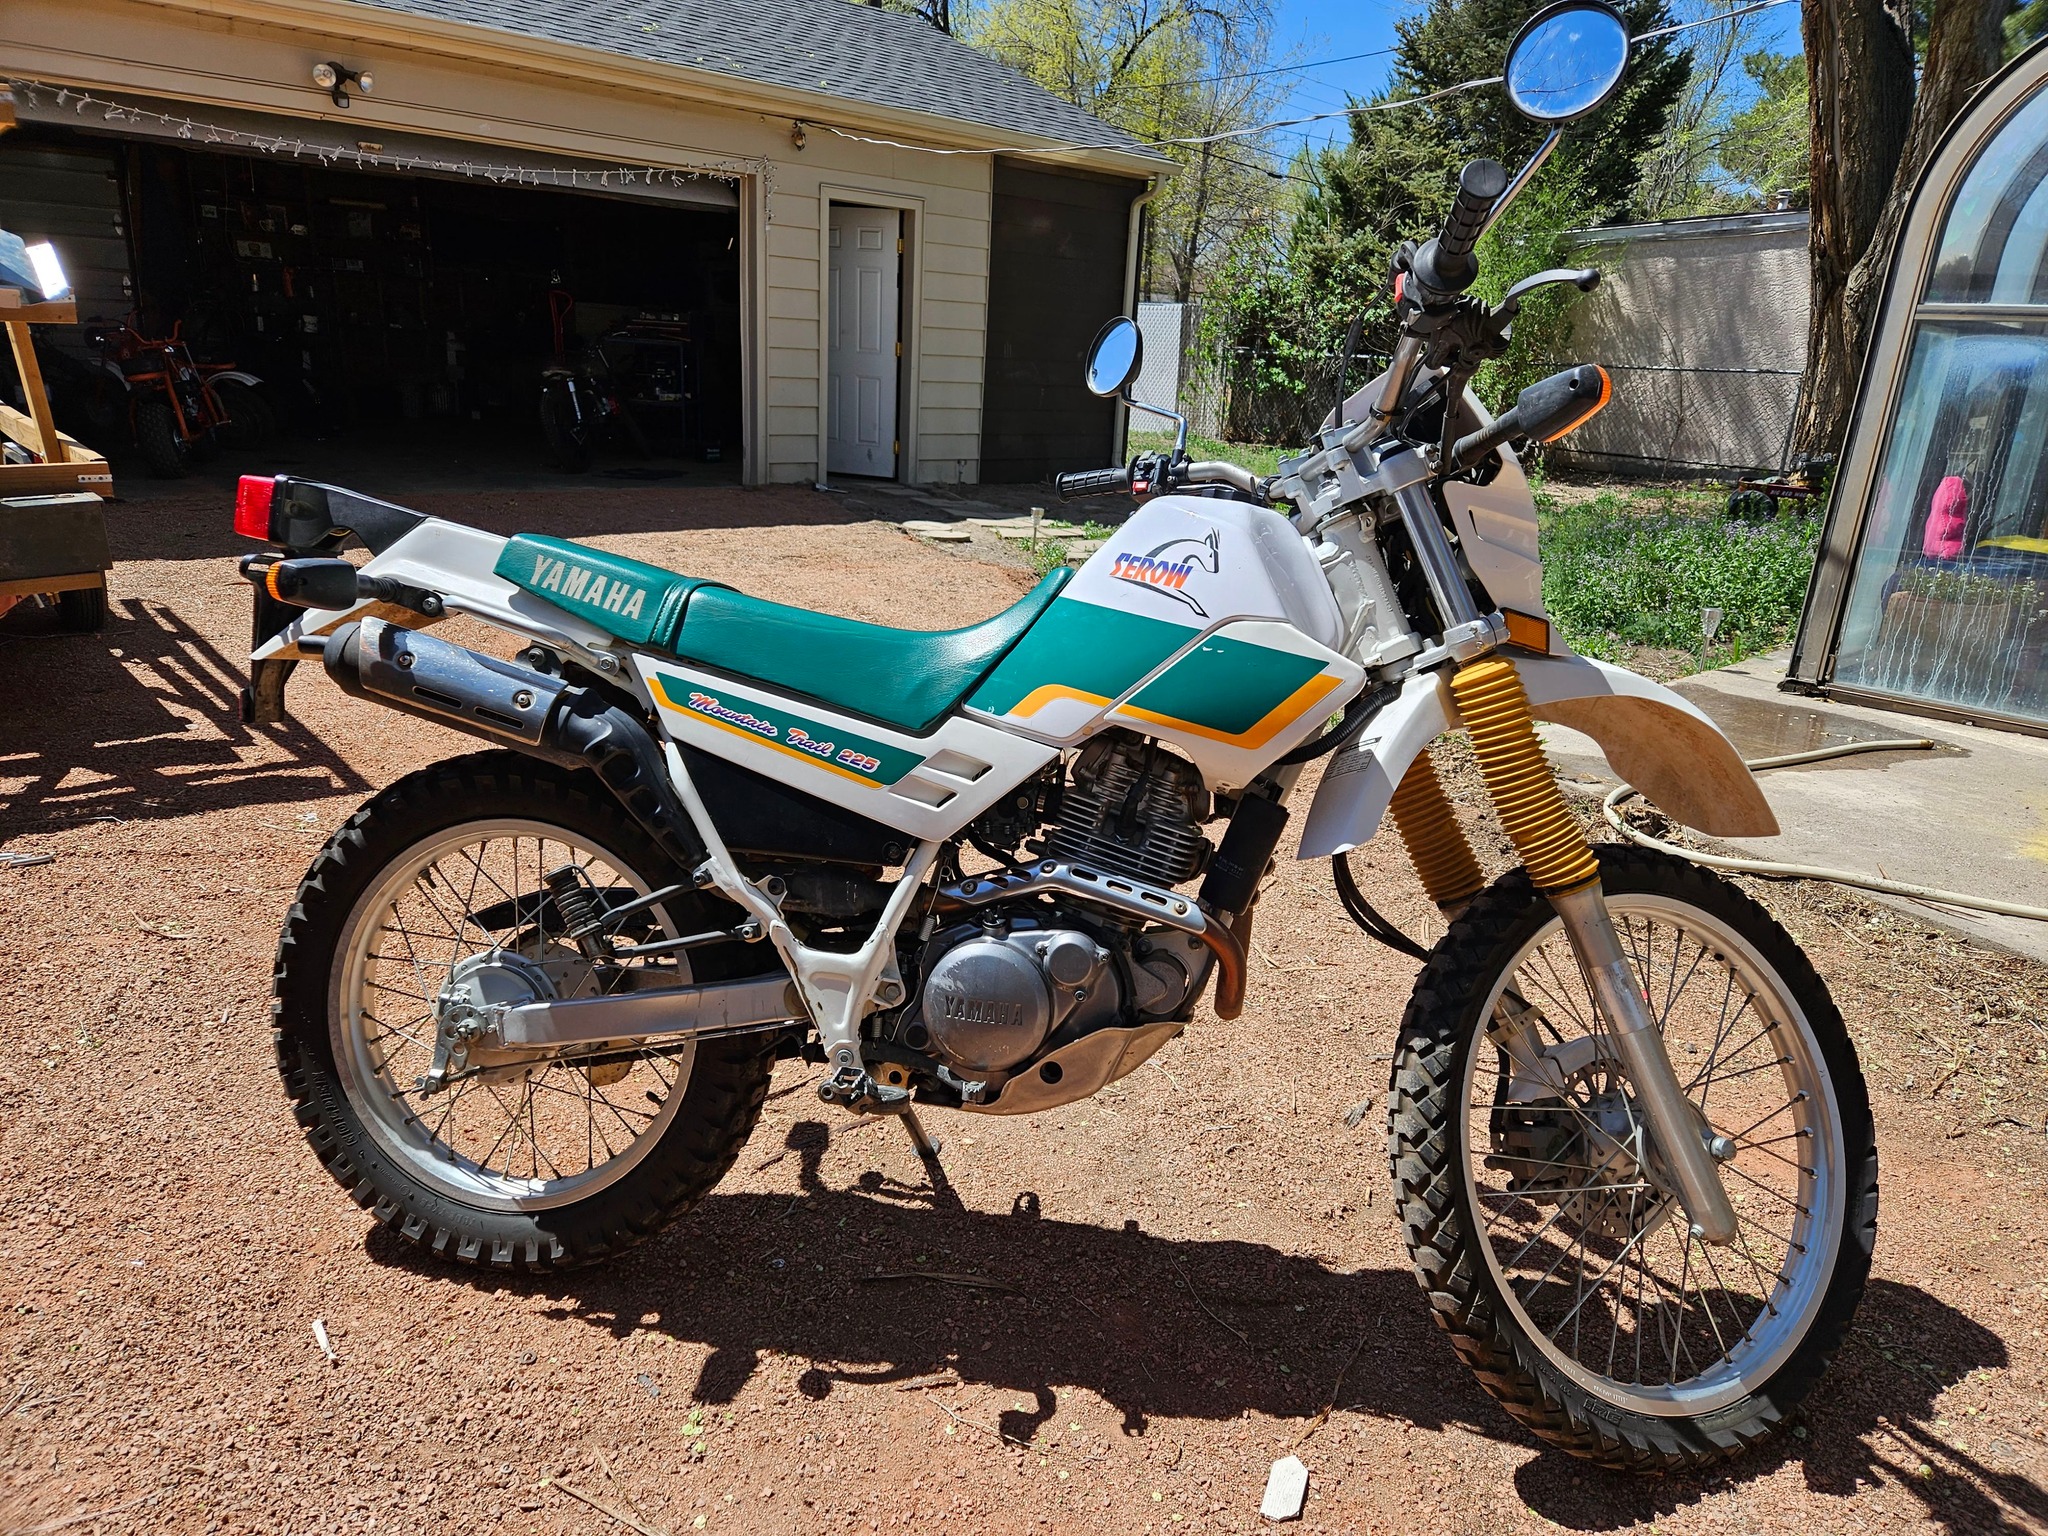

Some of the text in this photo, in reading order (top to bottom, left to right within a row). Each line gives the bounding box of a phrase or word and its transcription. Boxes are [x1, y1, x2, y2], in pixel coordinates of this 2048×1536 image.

[529, 554, 647, 620] YAMAHA
[1109, 552, 1194, 590] SEROW
[689, 692, 880, 773] Mountain Trail 225
[944, 994, 1023, 1026] YAMAHA
